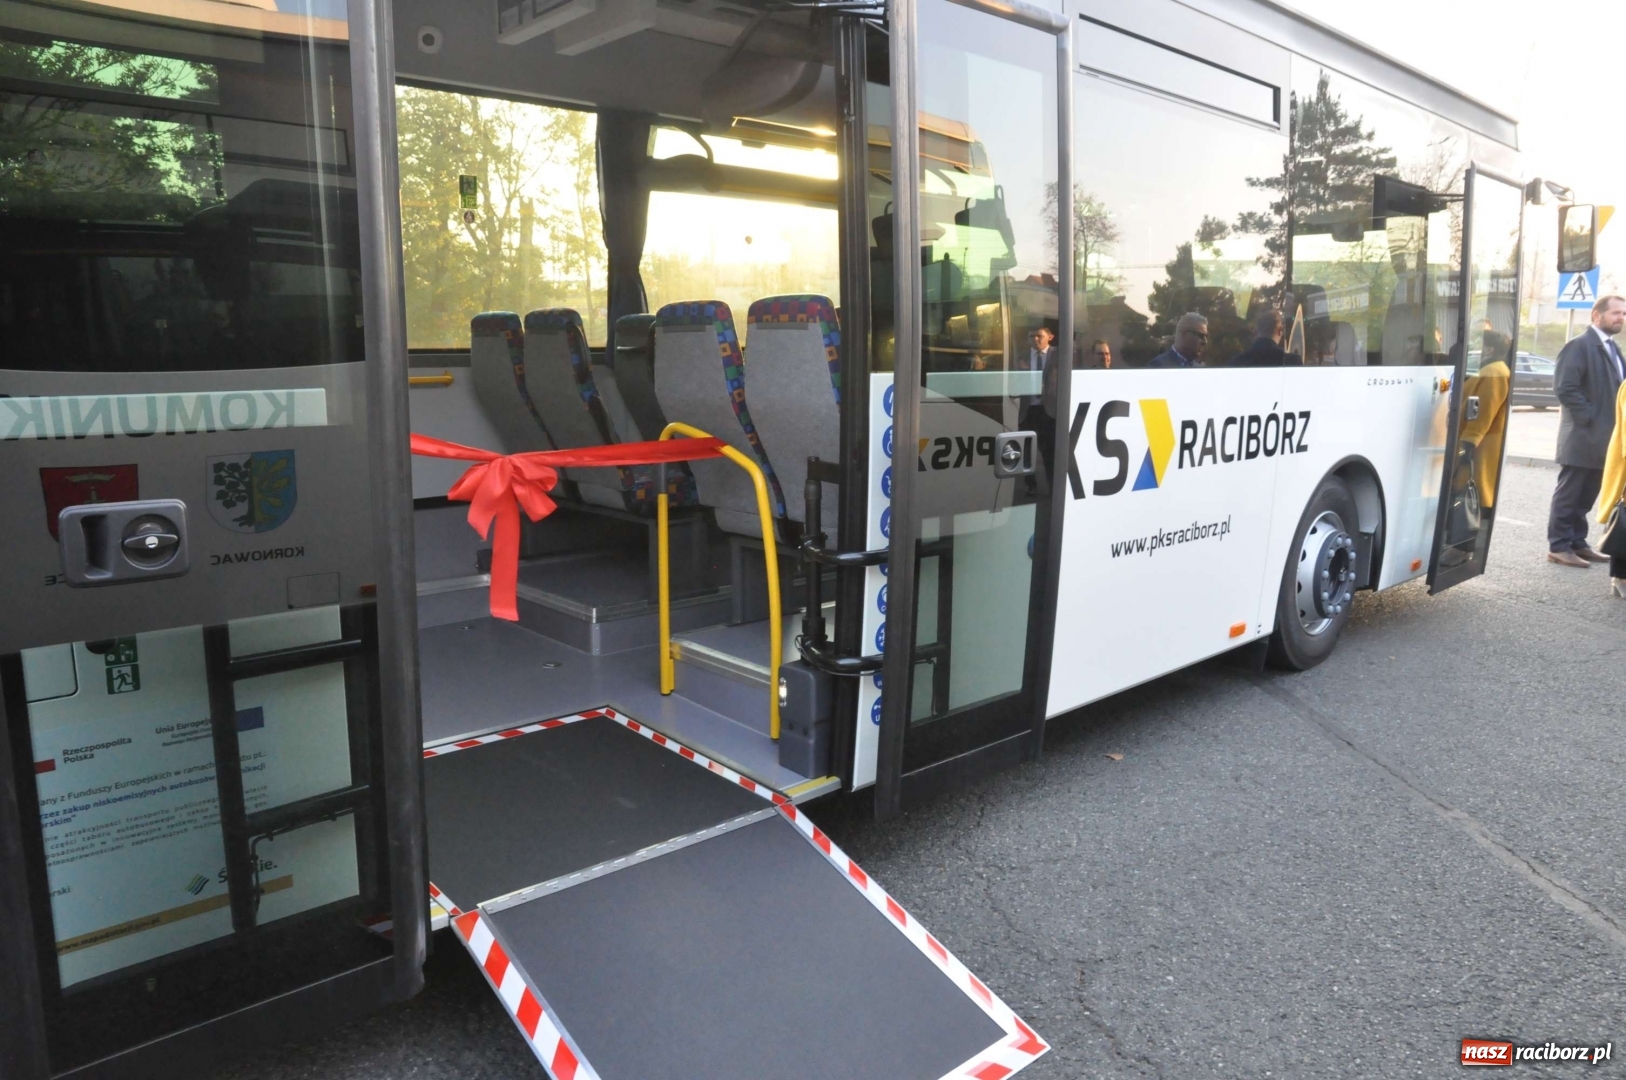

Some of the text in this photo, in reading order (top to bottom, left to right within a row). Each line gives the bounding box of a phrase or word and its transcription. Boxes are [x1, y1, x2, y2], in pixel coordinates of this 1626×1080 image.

[1178, 402, 1311, 469] RACIBÓRZ
[1110, 515, 1231, 558] www.pksraciborz.pl
[155, 725, 175, 734] Unia
[62, 737, 132, 756] Rzeczpospolita
[63, 752, 95, 763] Polska
[62, 803, 91, 815] zakup
[93, 785, 167, 808] niskoemisyjnych
[169, 776, 216, 790] autobusów
[67, 785, 113, 800] Funduszy
[114, 771, 172, 790] Europejskich
